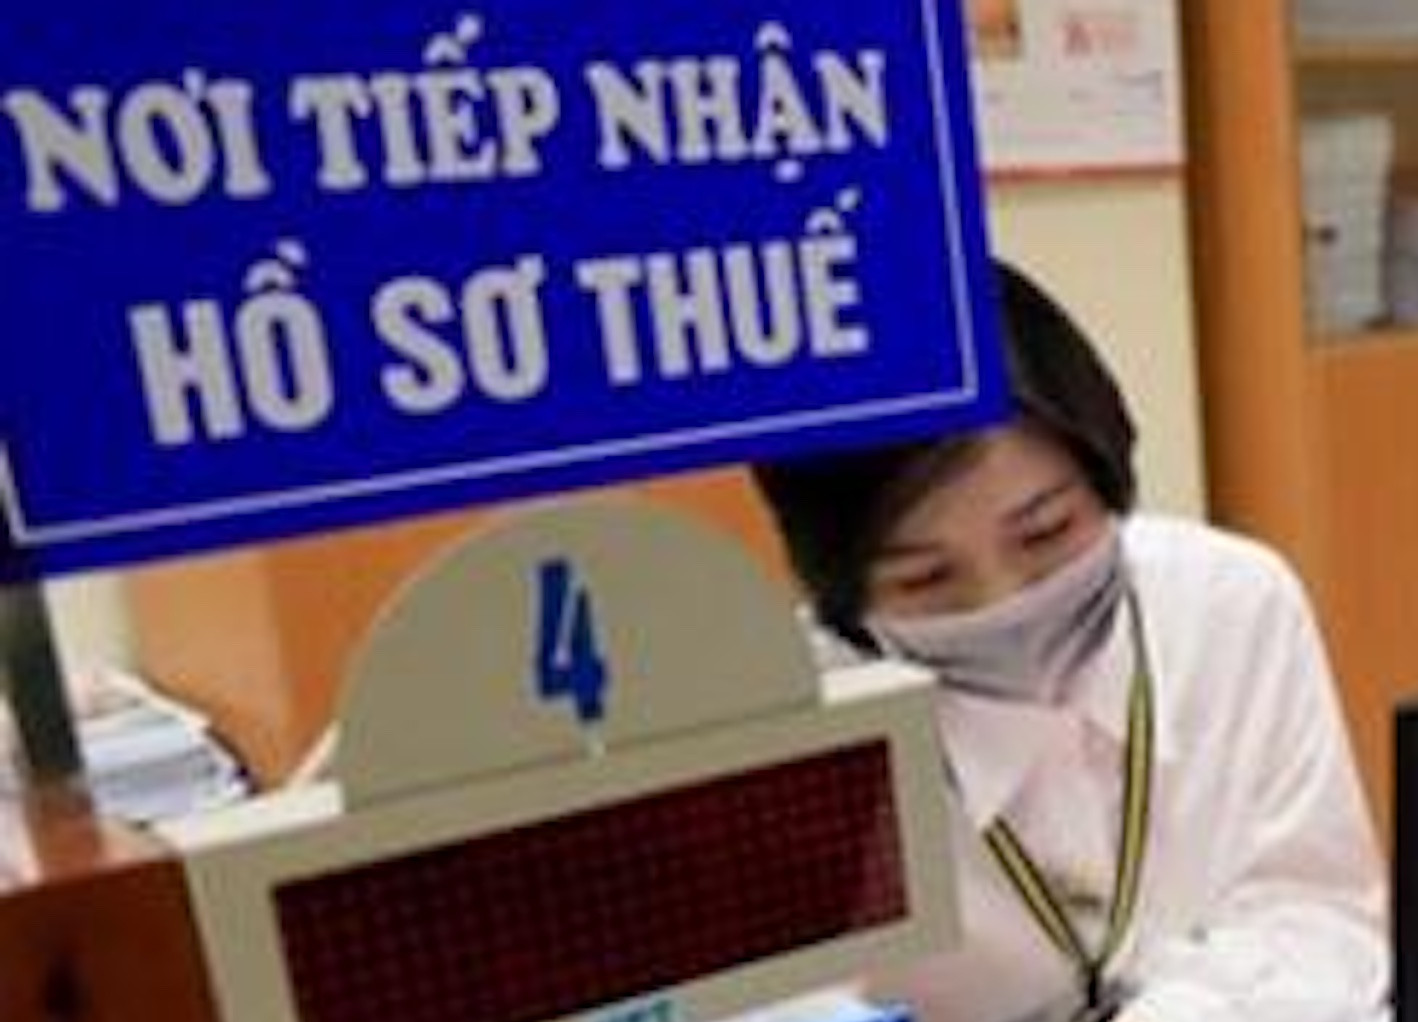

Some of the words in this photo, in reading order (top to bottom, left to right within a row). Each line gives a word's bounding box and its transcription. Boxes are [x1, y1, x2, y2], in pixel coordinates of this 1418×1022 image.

[6, 71, 267, 209] NƠI
[291, 17, 558, 188] TIẾP
[588, 24, 885, 179] NHẬN
[132, 243, 331, 443] HỒ
[374, 257, 546, 410] SƠ
[577, 190, 866, 381] THUẾ
[537, 557, 606, 721] 4
